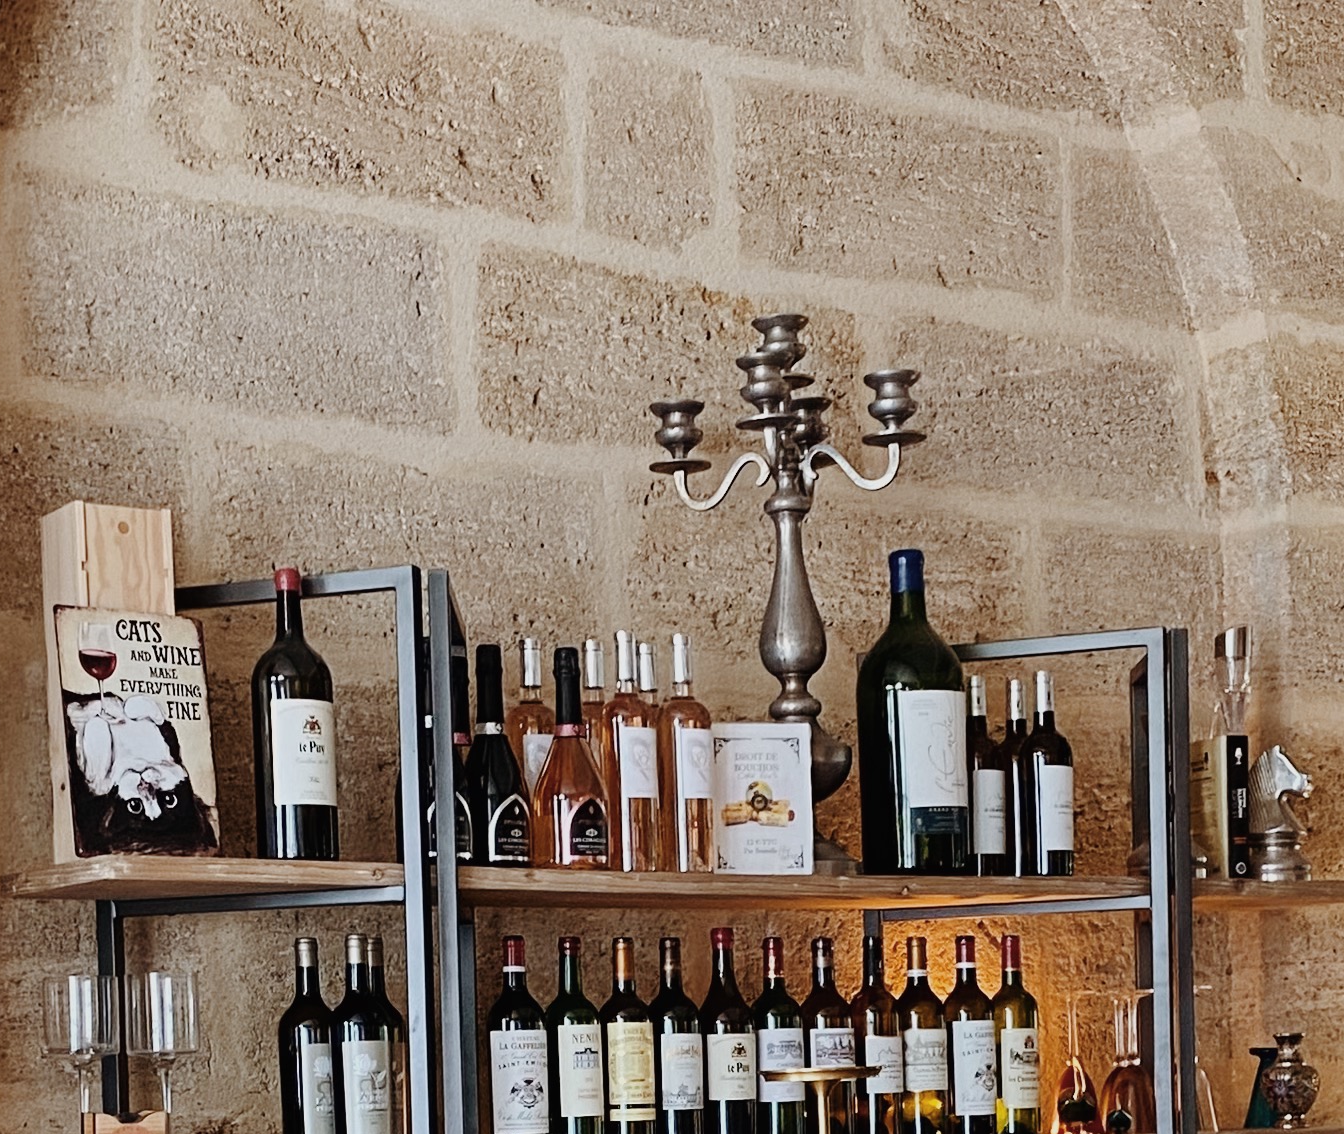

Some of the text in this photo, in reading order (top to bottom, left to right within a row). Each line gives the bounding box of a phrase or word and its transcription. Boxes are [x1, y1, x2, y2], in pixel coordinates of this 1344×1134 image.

[116, 619, 162, 643] CATS
[131, 645, 201, 667] AND WINE
[149, 667, 178, 680] MAKE
[120, 679, 202, 698] EVERYTHING
[166, 701, 201, 720] FINE
